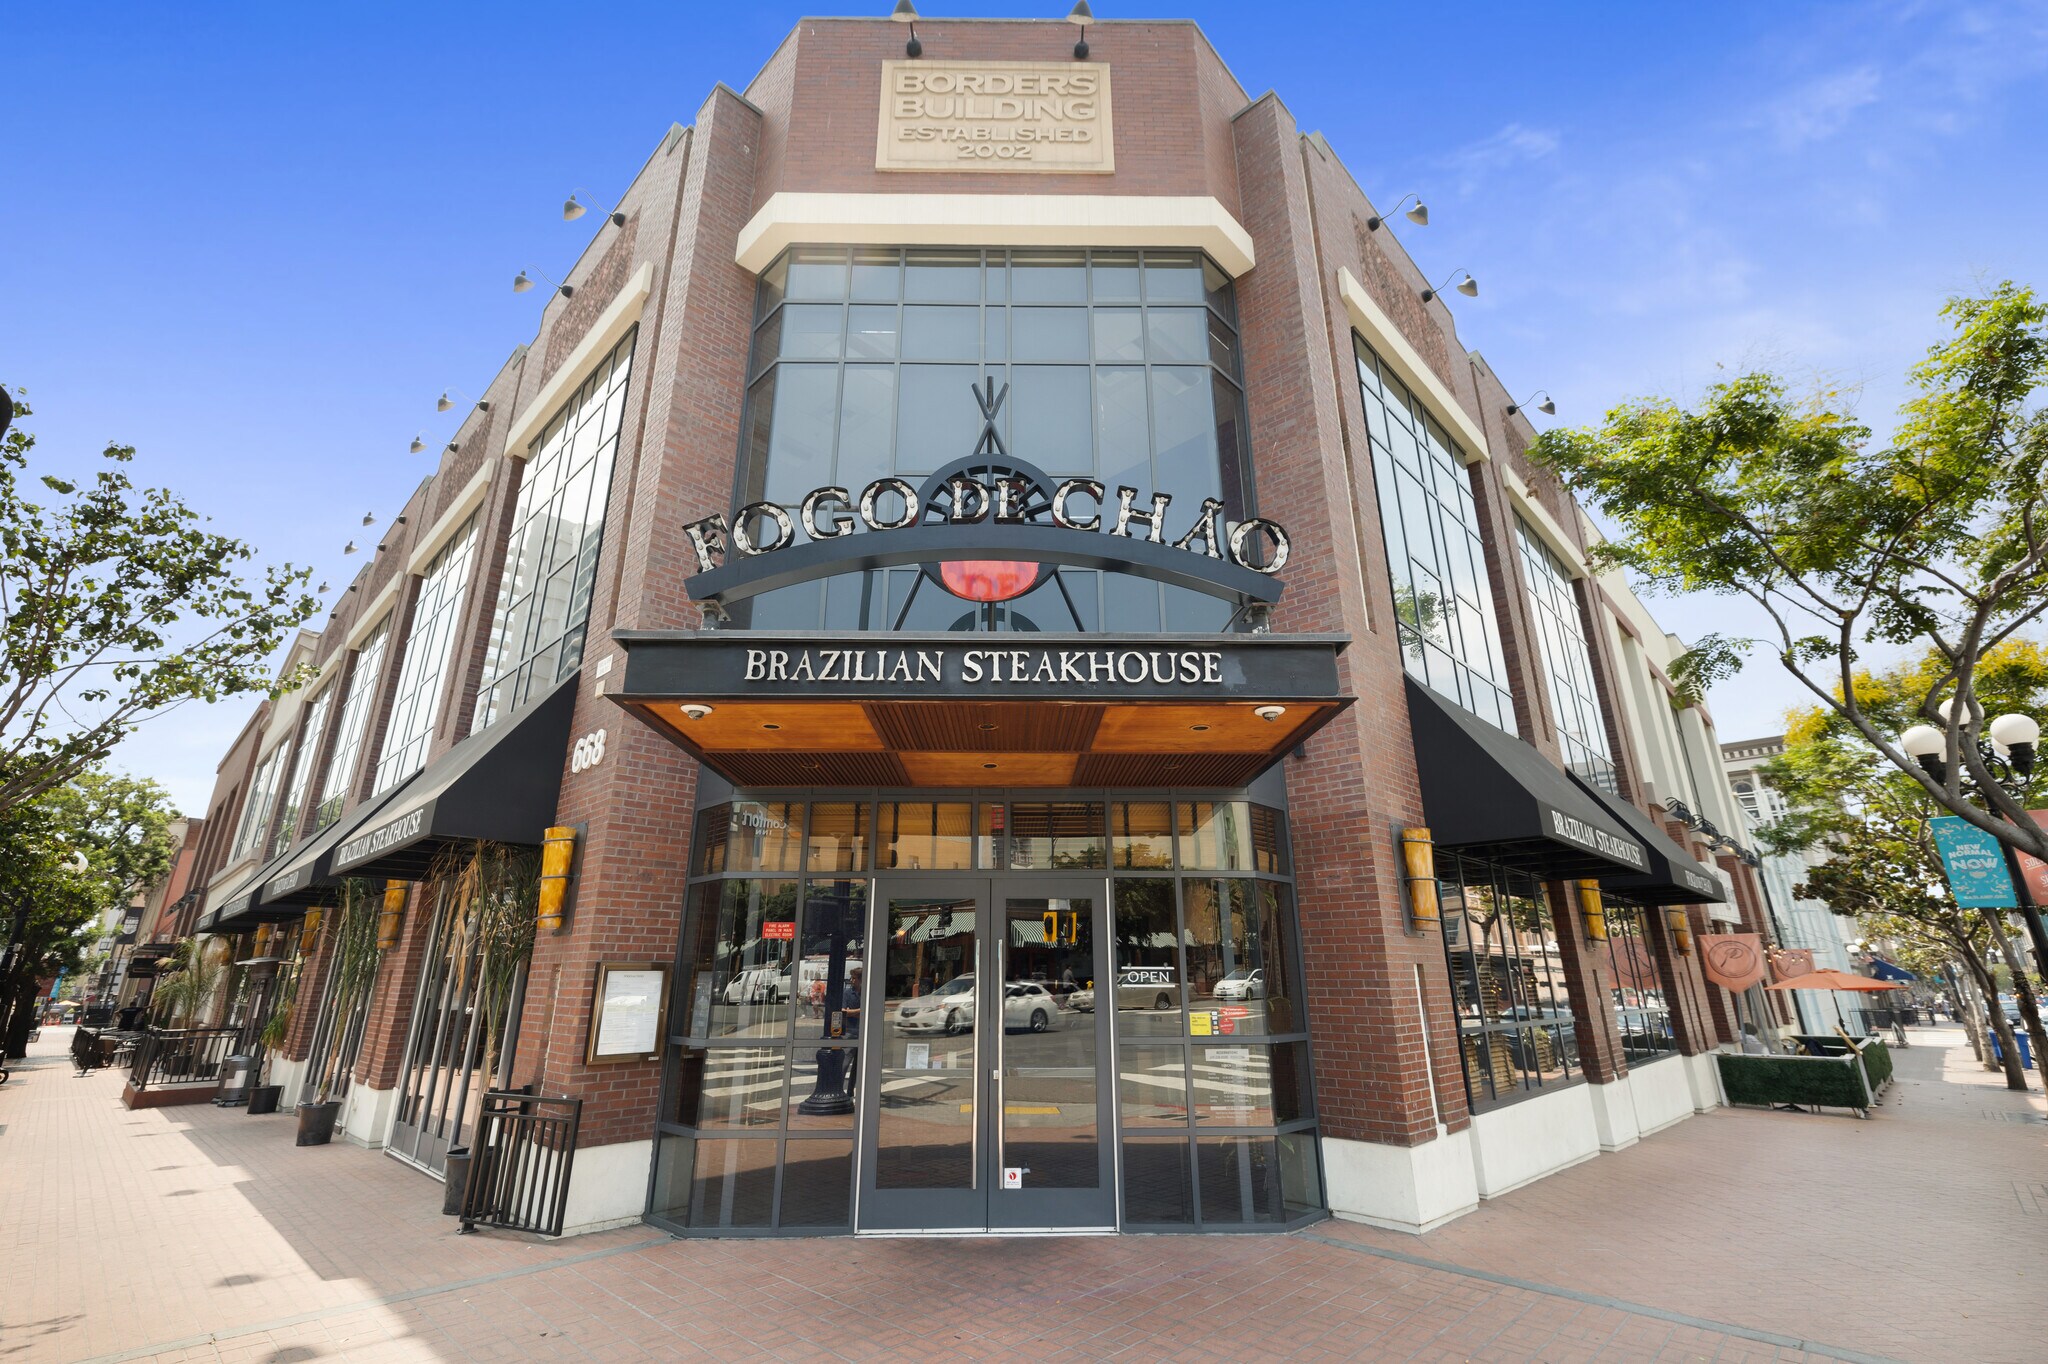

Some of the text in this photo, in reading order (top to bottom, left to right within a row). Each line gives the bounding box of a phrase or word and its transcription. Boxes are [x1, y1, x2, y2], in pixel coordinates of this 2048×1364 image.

[896, 72, 1097, 95] BORDERS
[894, 98, 1096, 120] BUILDING
[898, 126, 1093, 143] ESTABLISHED
[957, 144, 1032, 159] 2002
[682, 478, 920, 573] FOGO
[950, 477, 1027, 524] DE
[744, 649, 1224, 683] BRAZILIAN STEAKHOUSE
[571, 728, 608, 774] 668
[337, 808, 424, 867] BRAZILIAN STEAKHOUSE
[1551, 810, 1643, 867] BRAZILIAN STEAKHOUSE
[1955, 843, 1981, 851] NEW
[1948, 849, 1995, 859] NORMAL
[1950, 858, 1998, 871] NOW
[1127, 971, 1170, 983] OPEN
